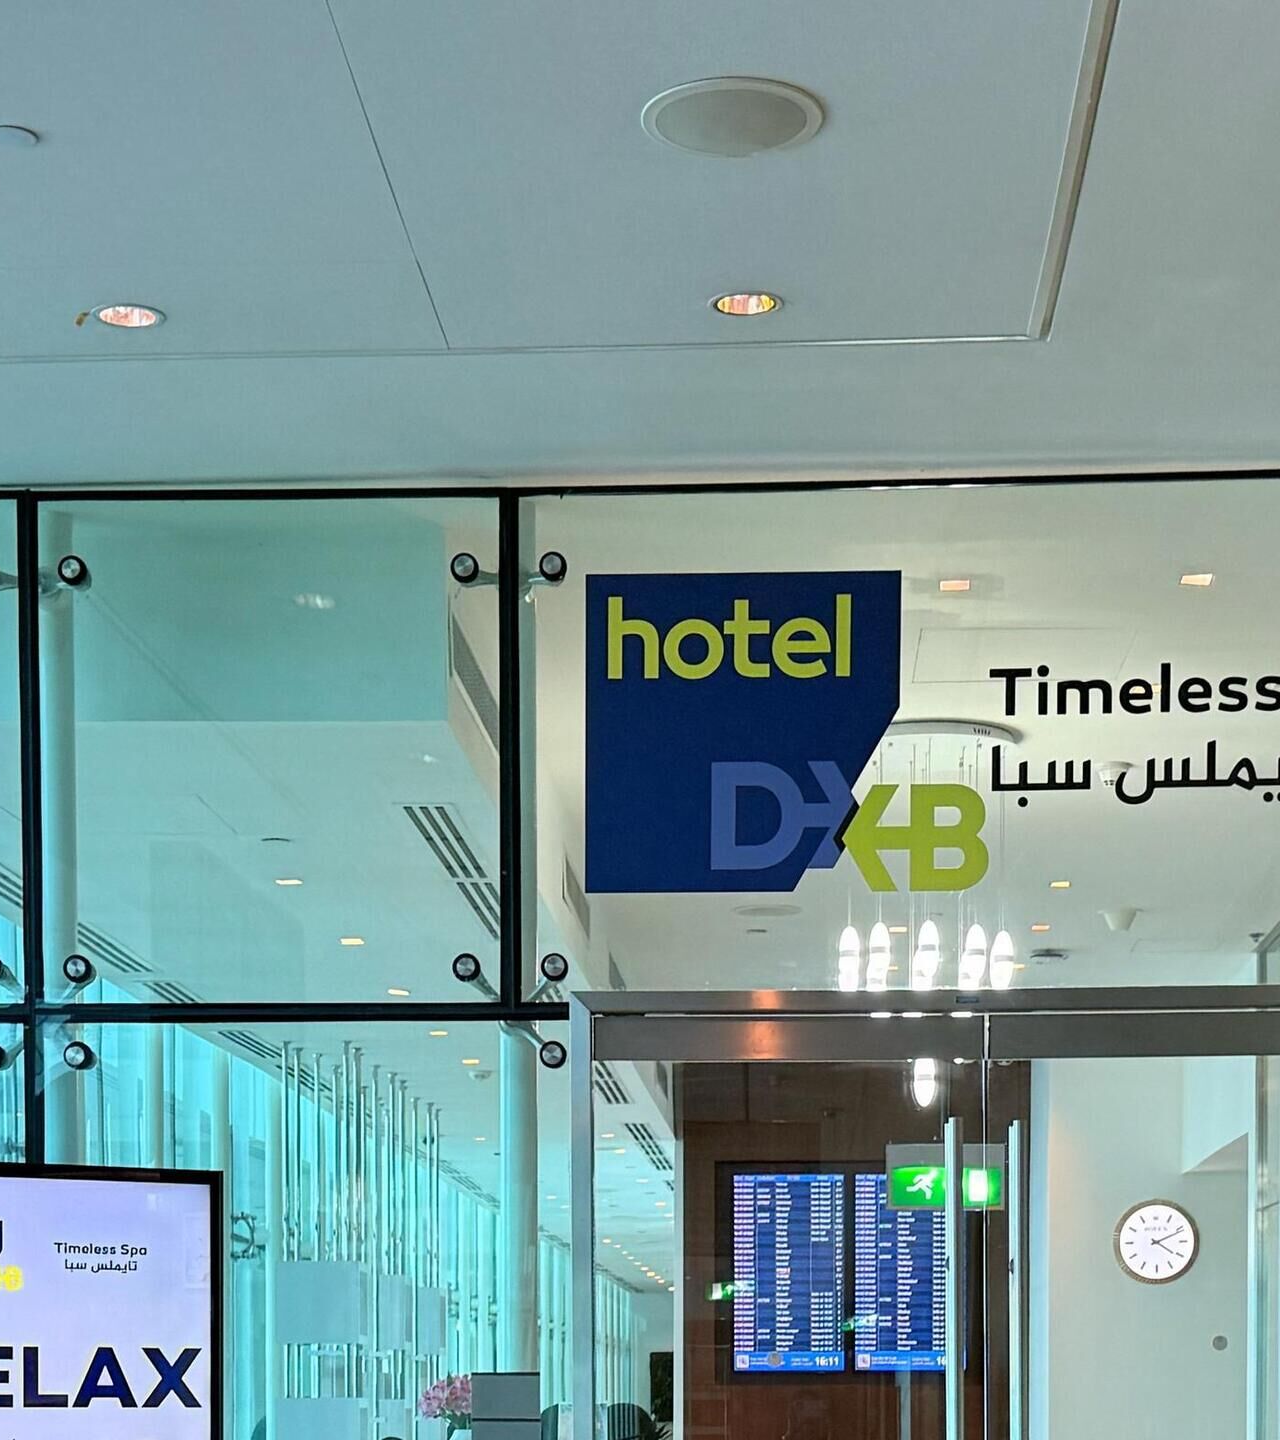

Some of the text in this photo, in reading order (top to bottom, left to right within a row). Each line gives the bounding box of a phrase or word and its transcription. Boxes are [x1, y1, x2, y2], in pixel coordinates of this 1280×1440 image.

[608, 593, 851, 680] hotel
[991, 744, 1091, 808] سبا
[710, 760, 990, 892] DXB
[53, 1242, 148, 1258] Timeless Spa
[64, 1258, 138, 1273] تايملس سبا
